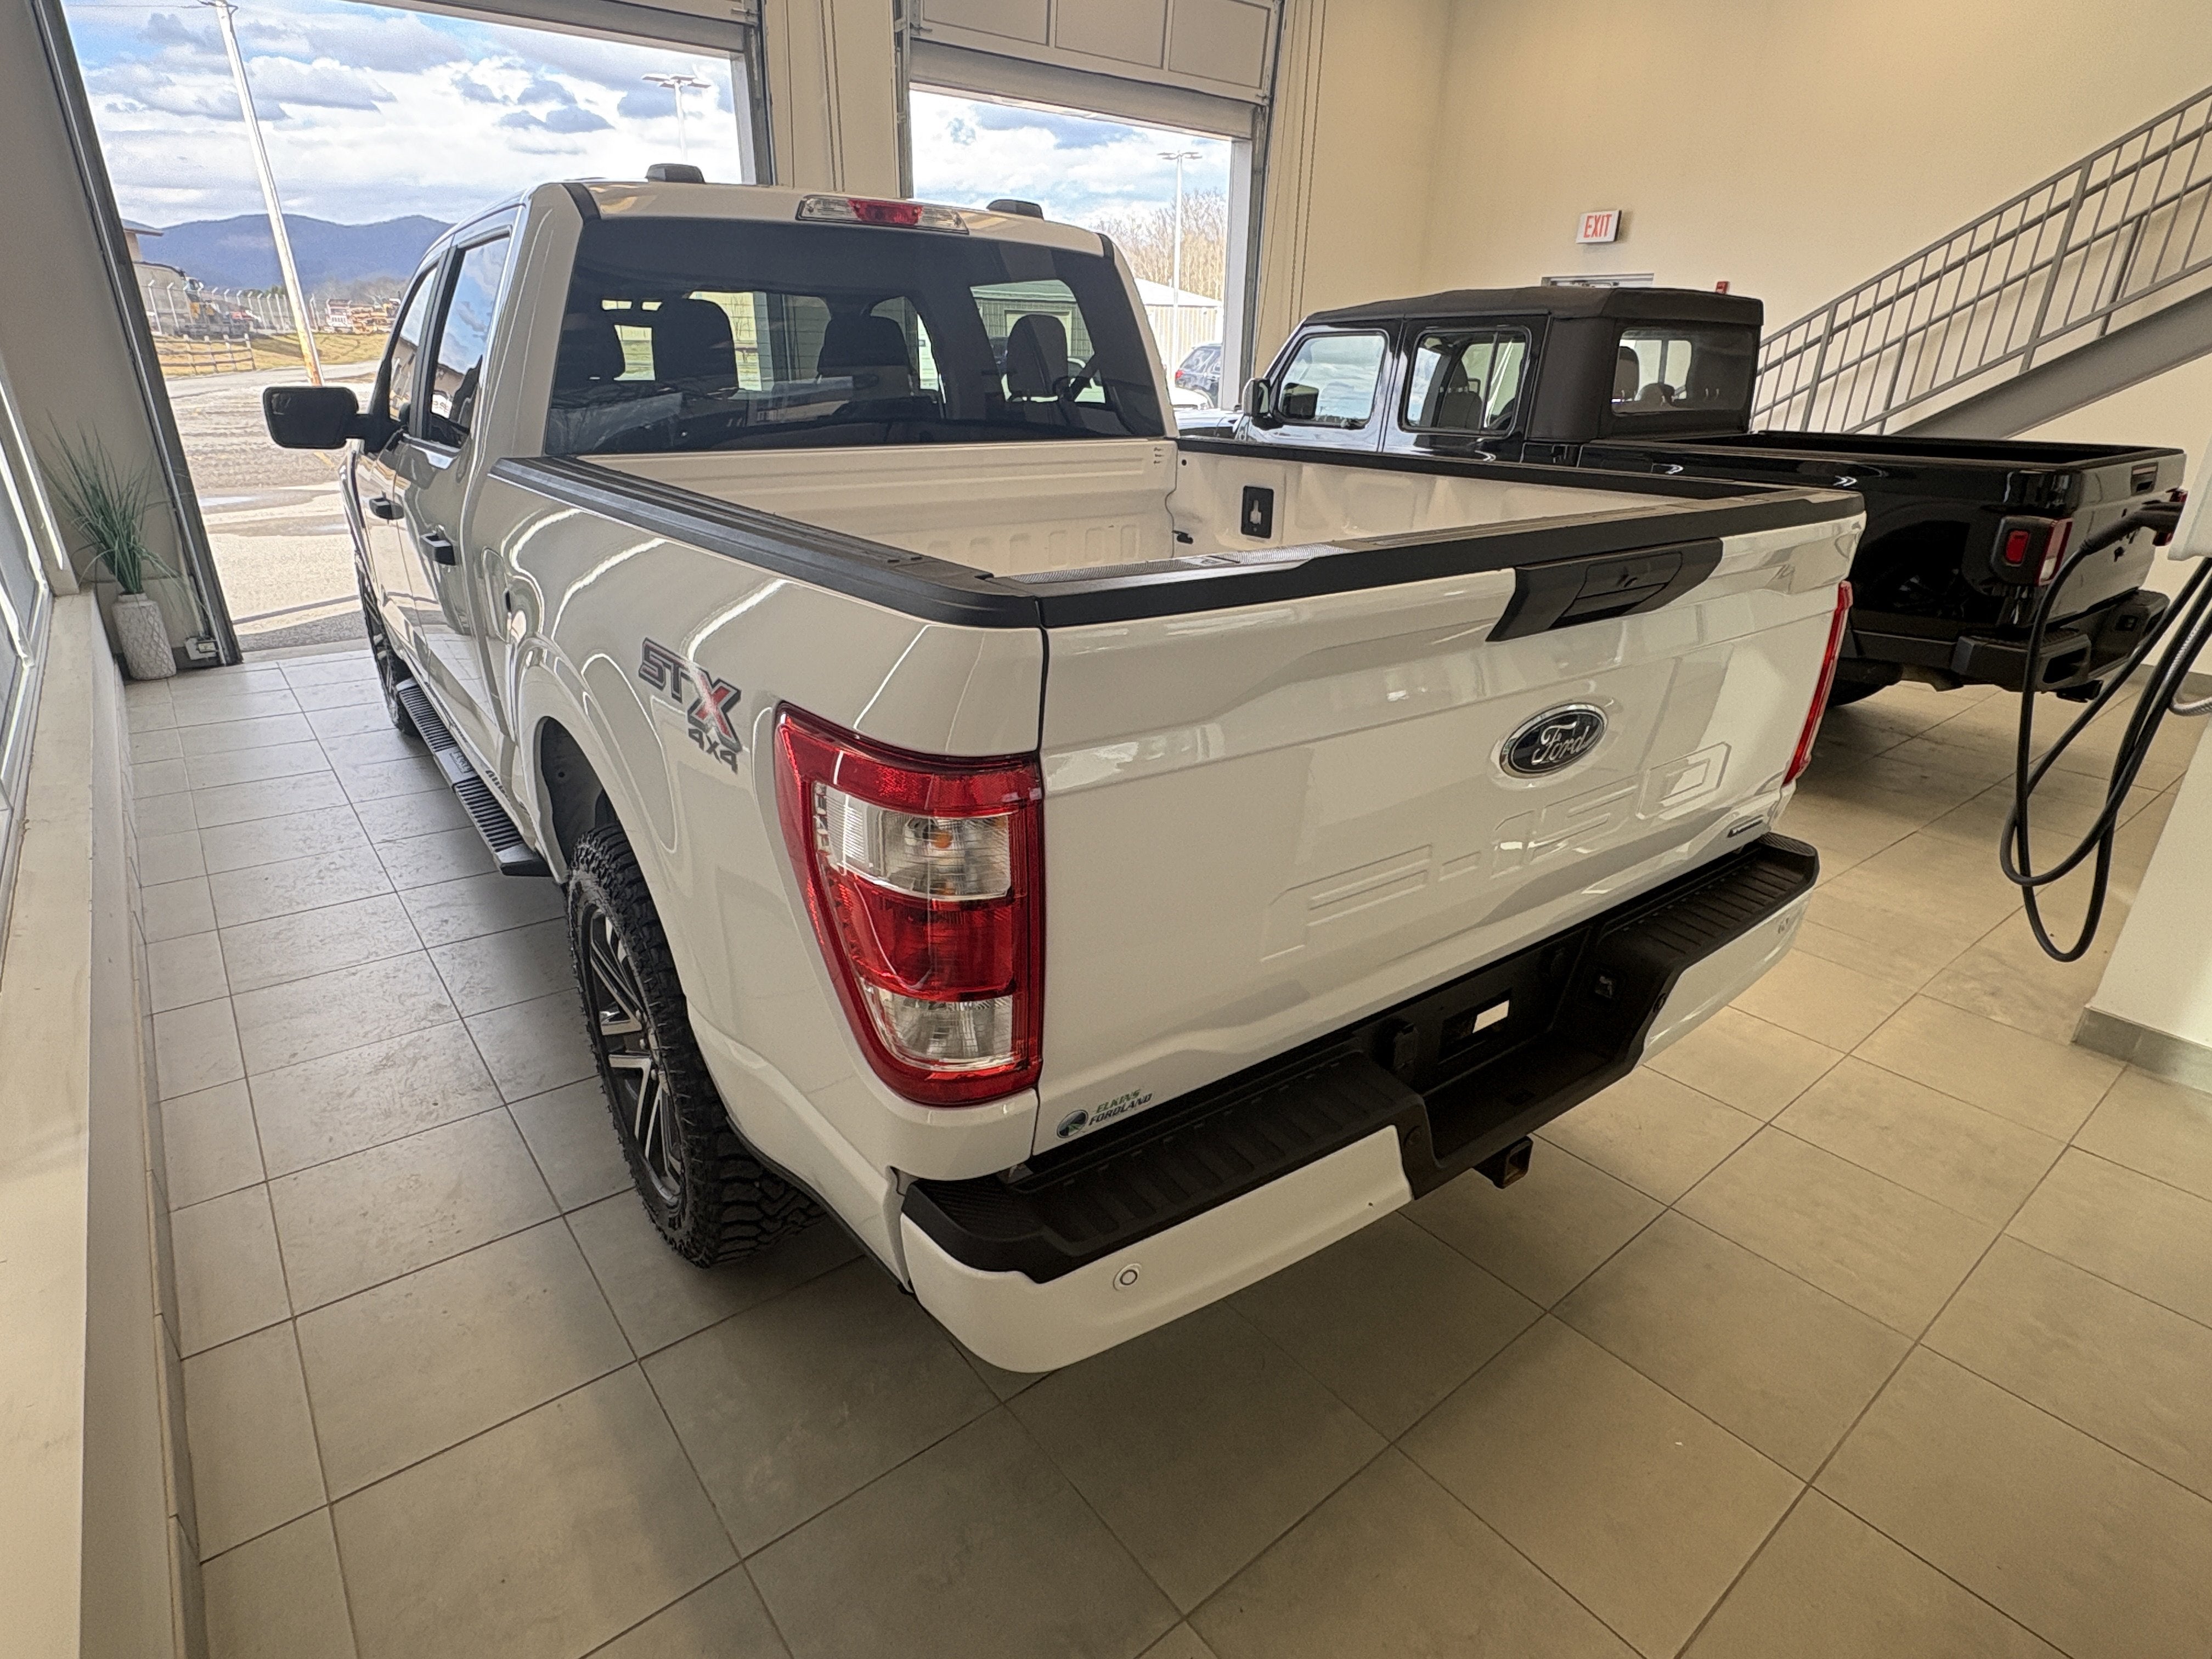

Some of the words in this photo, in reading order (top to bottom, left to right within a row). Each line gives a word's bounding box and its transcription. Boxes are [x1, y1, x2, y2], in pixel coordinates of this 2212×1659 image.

[1583, 214, 1612, 238] EXIT
[638, 637, 742, 753] STX
[1531, 721, 1590, 765] Ford
[1260, 742, 1732, 961] F-150
[1088, 1093, 1153, 1126] FORDLAND
[1096, 1088, 1141, 1114] ELKINS
